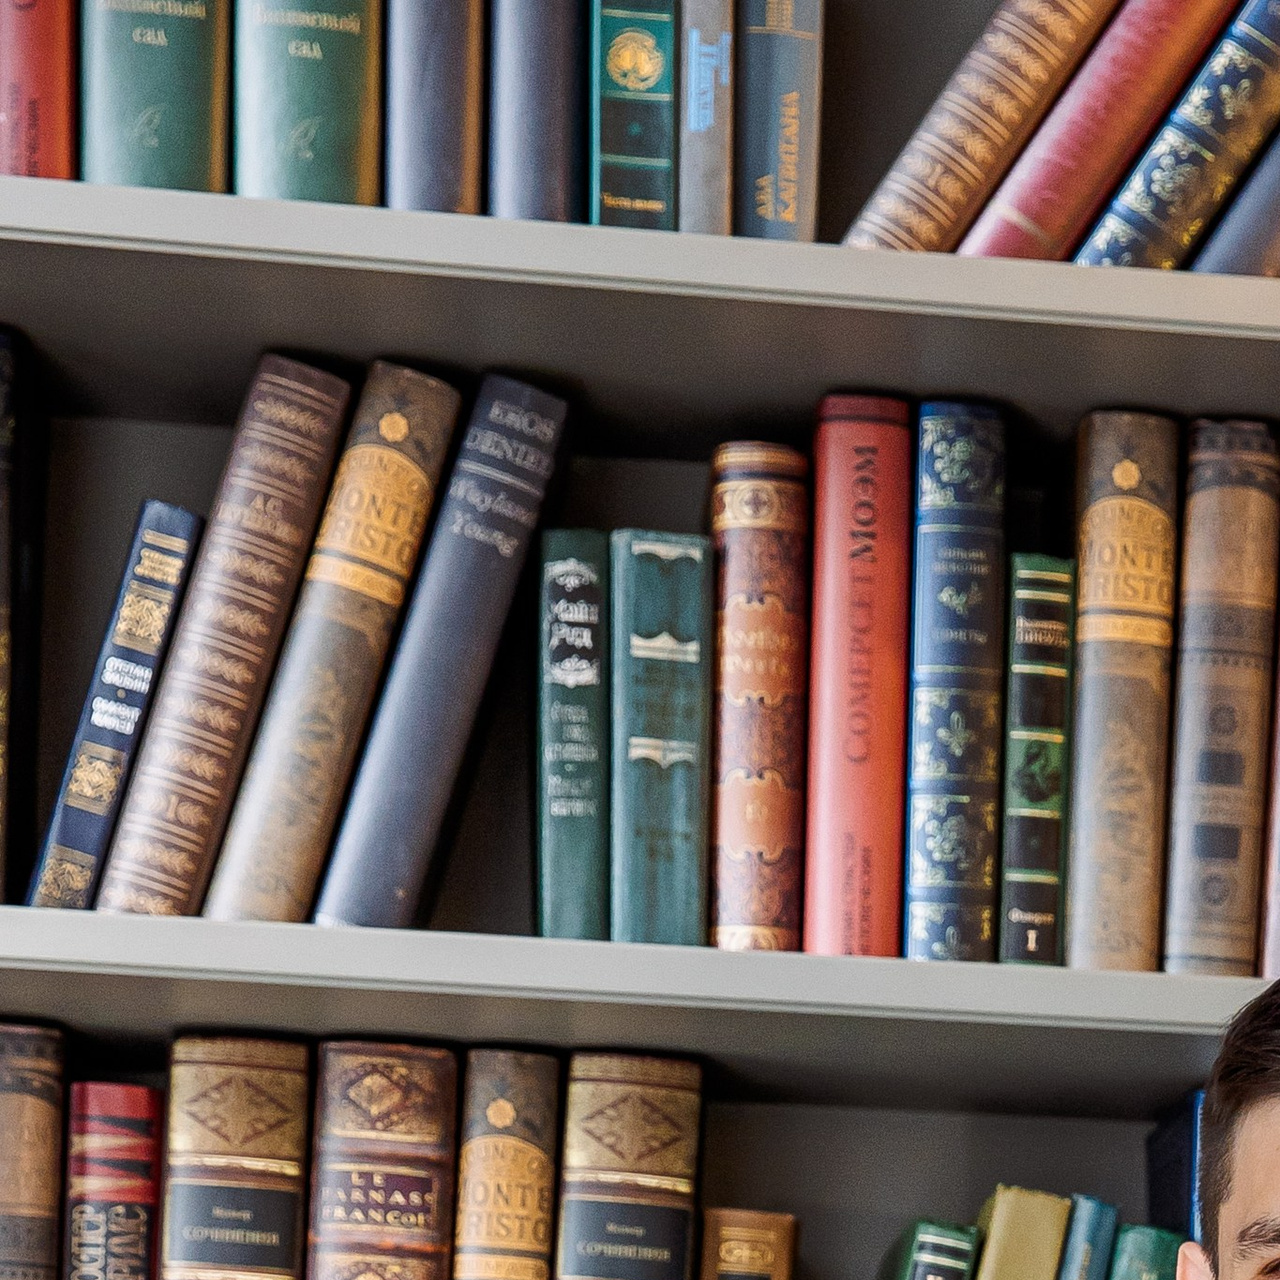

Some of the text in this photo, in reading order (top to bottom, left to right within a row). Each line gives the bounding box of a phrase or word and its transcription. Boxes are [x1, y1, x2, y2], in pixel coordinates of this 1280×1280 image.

[850, 446, 880, 563] МОЭМ
[452, 509, 519, 558] Young
[320, 1187, 435, 1207] PARNASS
[351, 1172, 387, 1188] LE
